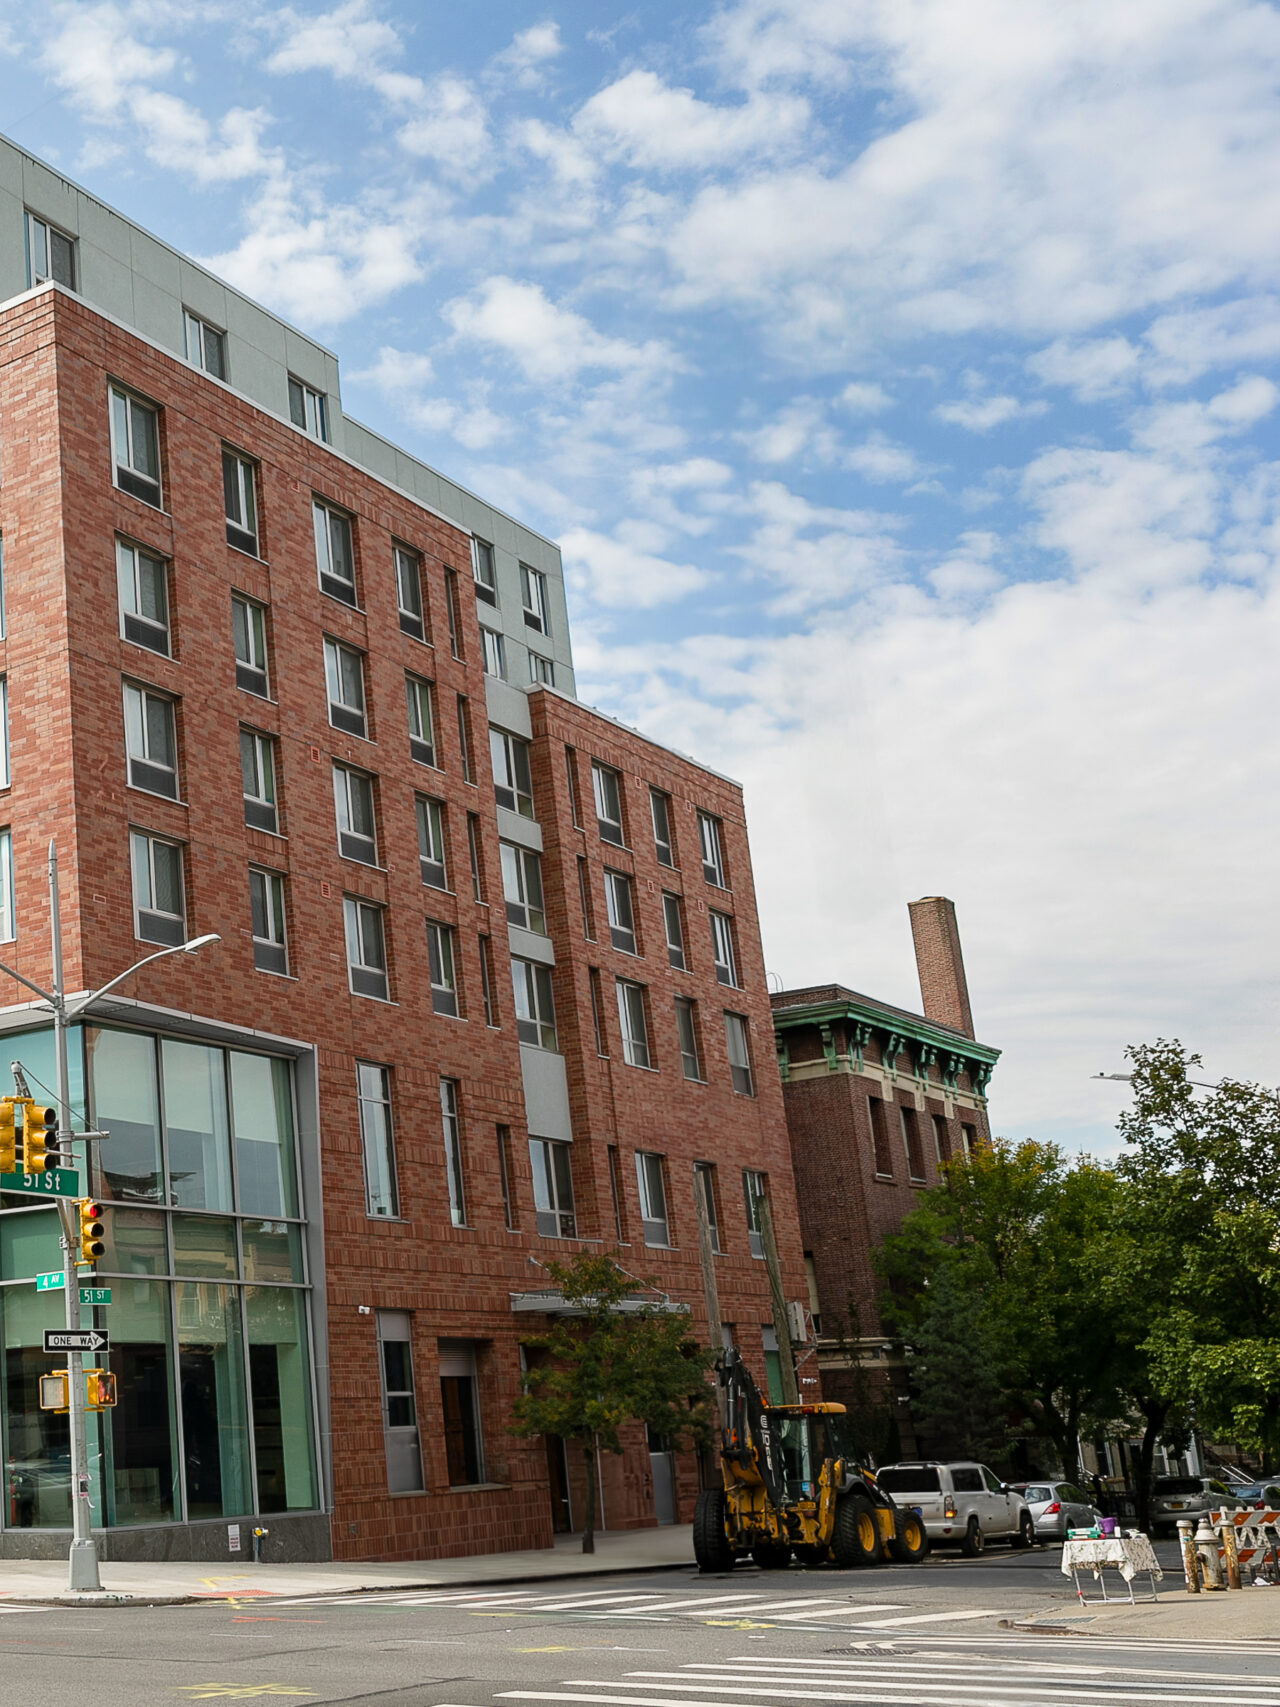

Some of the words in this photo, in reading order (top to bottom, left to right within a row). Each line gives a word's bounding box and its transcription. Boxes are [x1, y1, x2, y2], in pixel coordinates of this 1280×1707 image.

[23, 1173, 39, 1188] 51
[44, 1171, 61, 1191] St
[42, 1275, 49, 1288] 4
[84, 1289, 93, 1303] 51
[96, 1290, 105, 1300] ST
[53, 1336, 72, 1345] ONE
[80, 1336, 99, 1345] WAY
